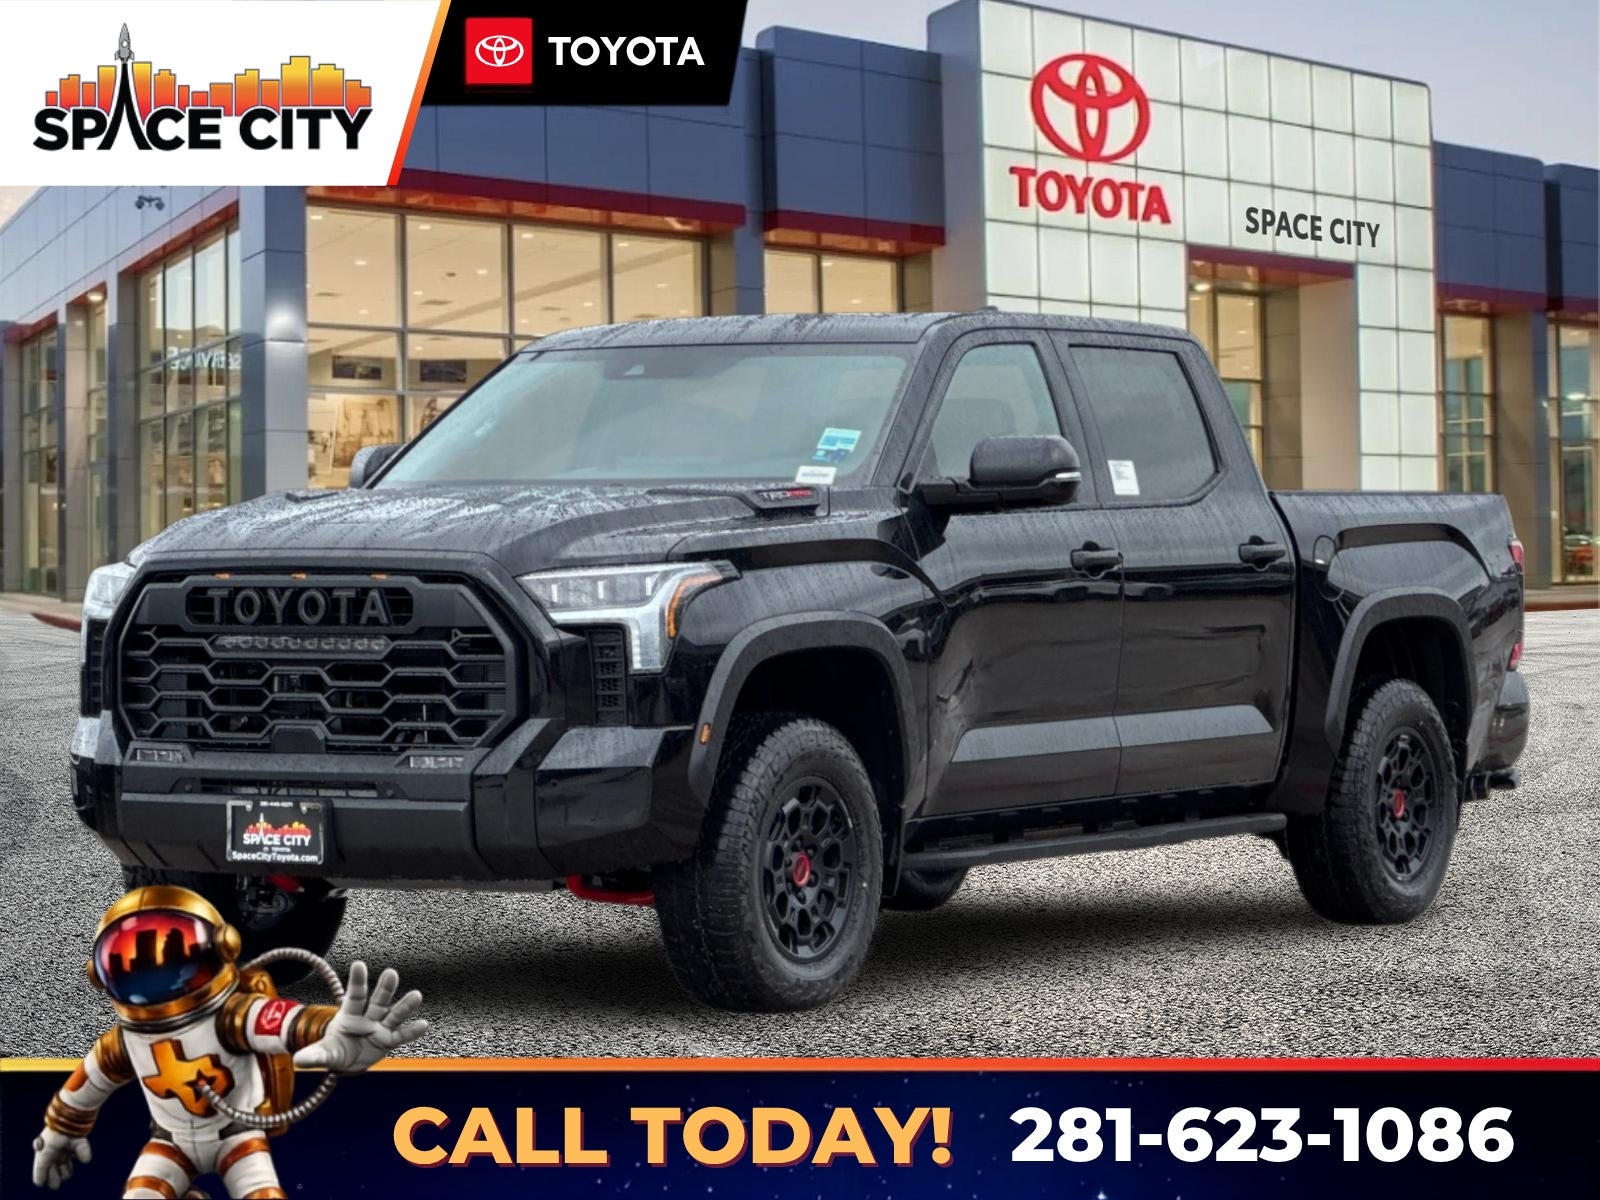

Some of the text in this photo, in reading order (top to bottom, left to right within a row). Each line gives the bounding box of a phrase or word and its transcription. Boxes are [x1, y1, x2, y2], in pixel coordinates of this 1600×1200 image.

[1009, 166, 1171, 225] TOYOTA
[1245, 207, 1381, 249] SPACE CITY
[206, 588, 393, 625] TOYOTA
[231, 851, 318, 863] SpaceCityToyota.com
[243, 832, 311, 847] SPACE CITY
